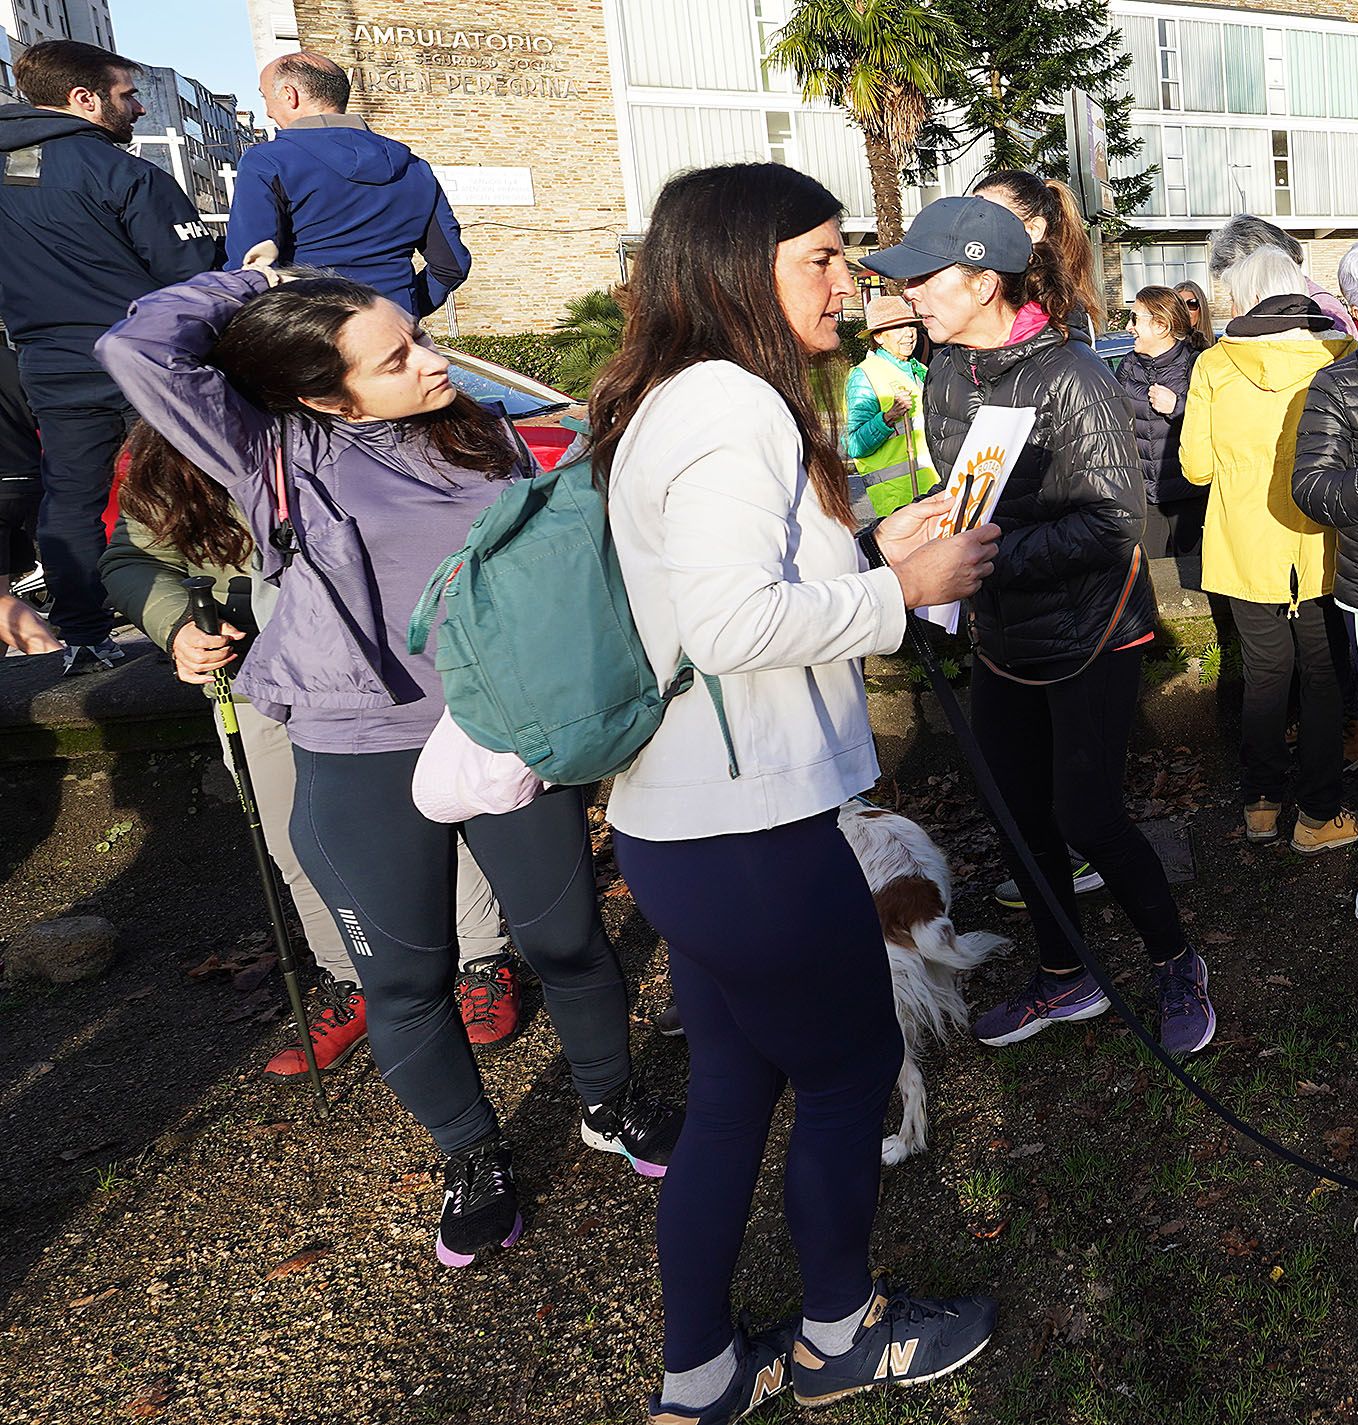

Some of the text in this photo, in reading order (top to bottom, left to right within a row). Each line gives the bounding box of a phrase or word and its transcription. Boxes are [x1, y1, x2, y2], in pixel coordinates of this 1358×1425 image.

[354, 25, 553, 54] AMBULATORIO
[355, 50, 561, 73] DE LA SEGURIDAD SOCIAL
[445, 72, 580, 98] PEREGRINA
[173, 220, 209, 241] HH
[977, 460, 1000, 475] ROTAR
